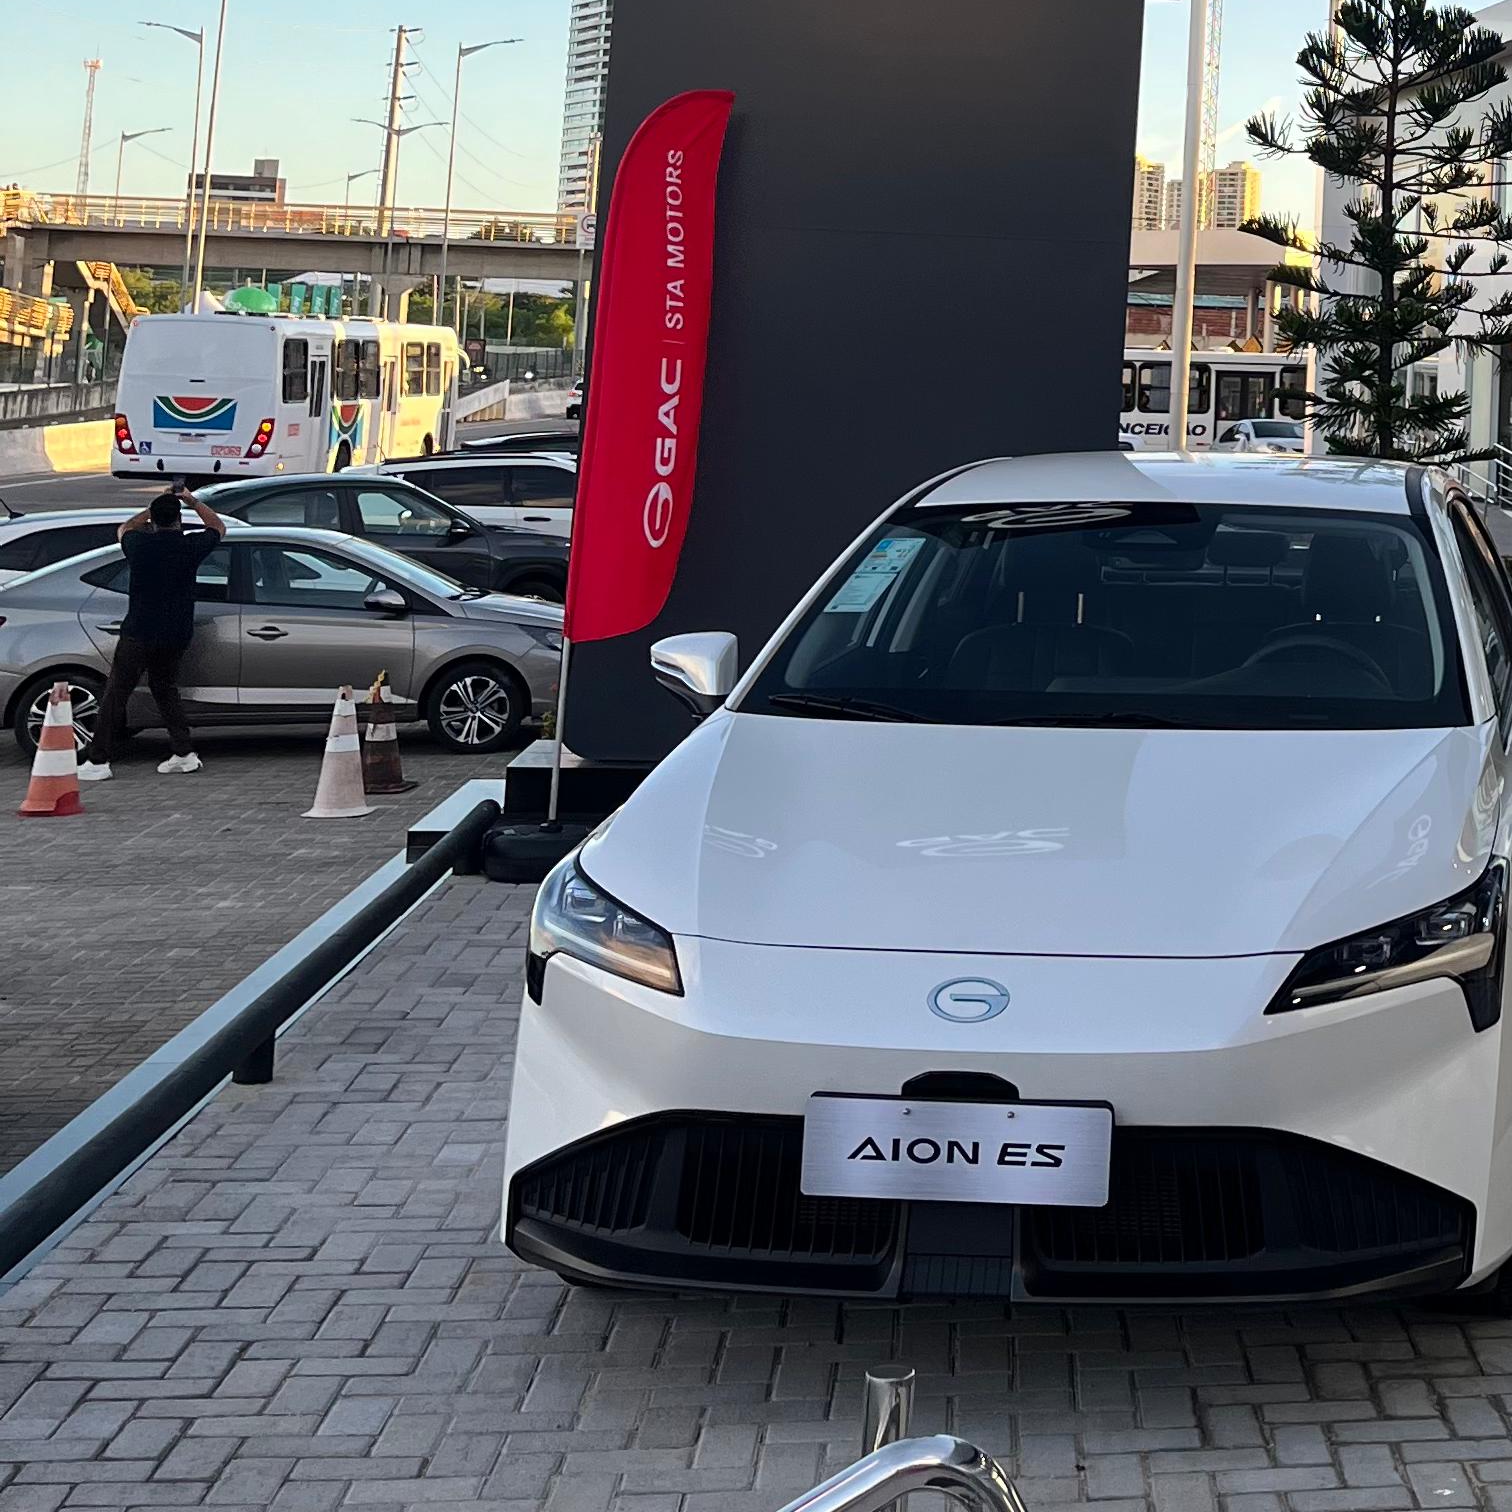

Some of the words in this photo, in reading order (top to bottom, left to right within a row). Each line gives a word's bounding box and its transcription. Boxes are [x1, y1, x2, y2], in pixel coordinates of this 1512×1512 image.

[665, 149, 685, 269] MOTORS
[665, 278, 685, 330] STA
[654, 357, 682, 476] GAC
[847, 1136, 980, 1165] AION
[997, 1142, 1066, 1168] ES
